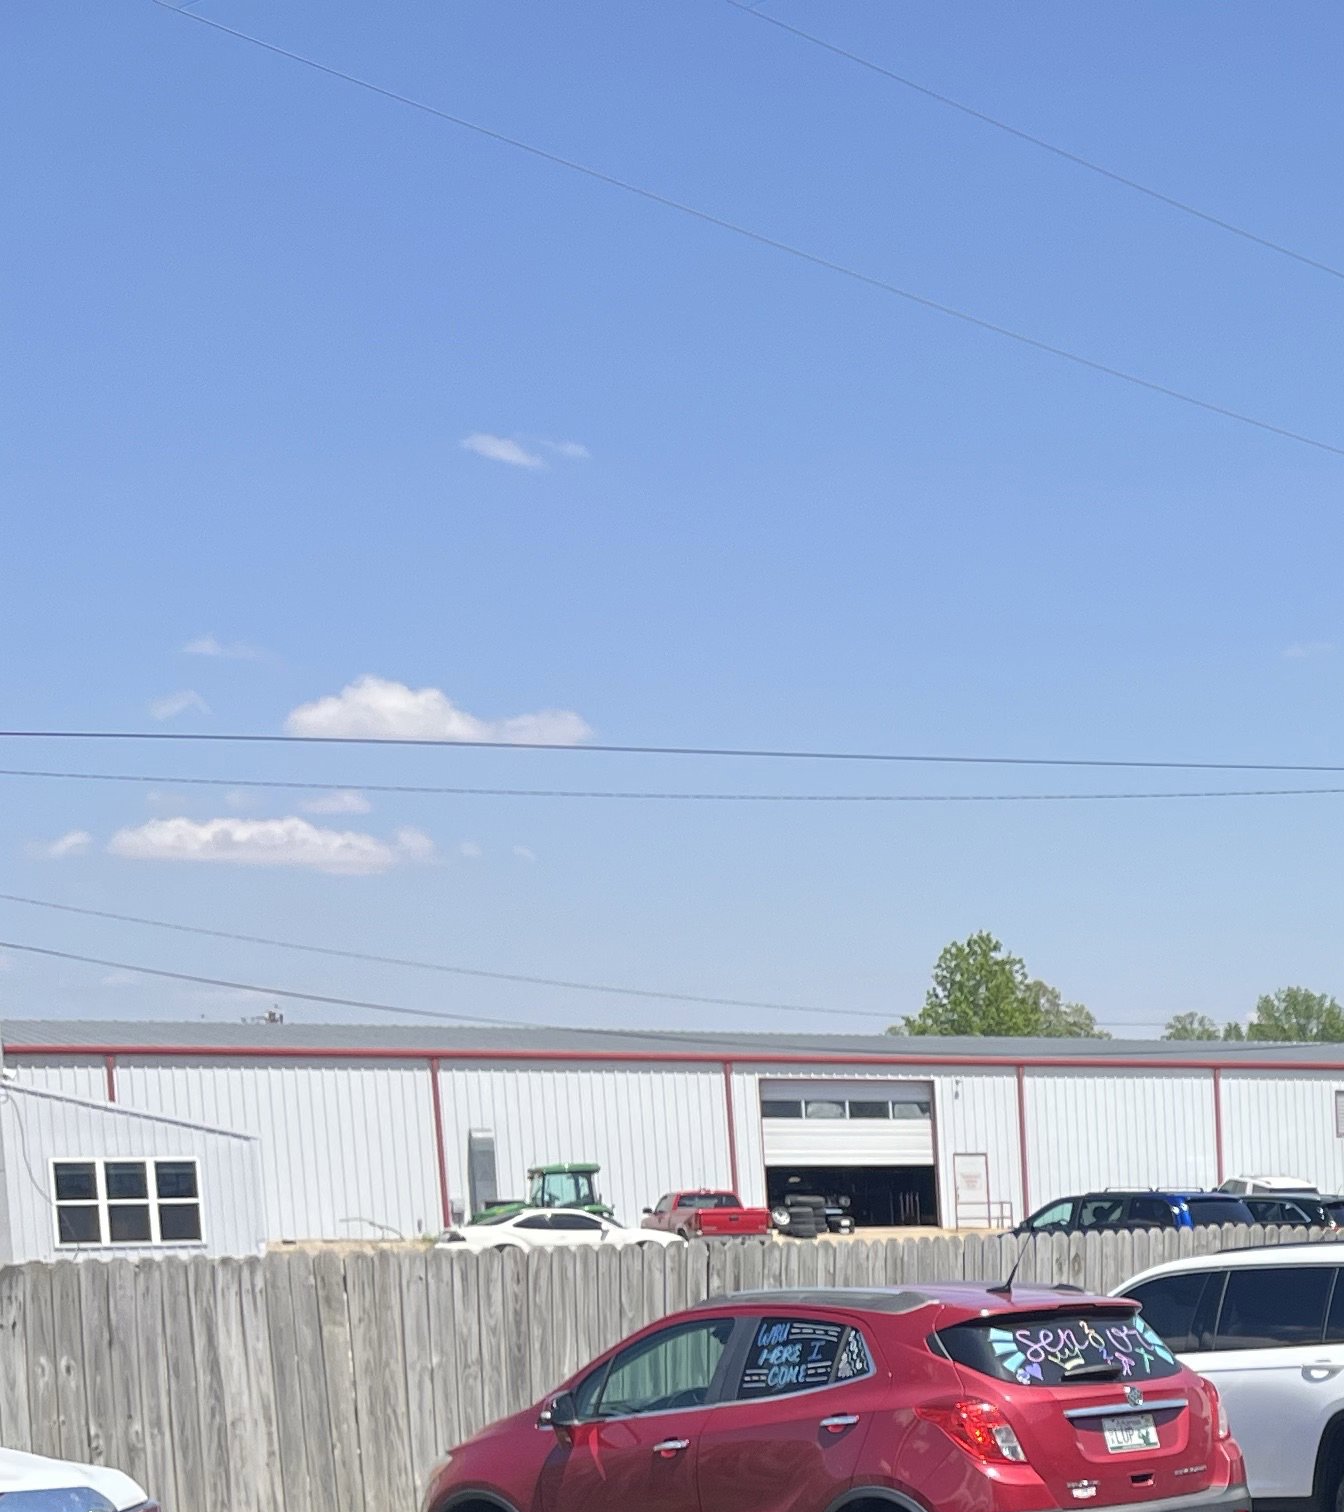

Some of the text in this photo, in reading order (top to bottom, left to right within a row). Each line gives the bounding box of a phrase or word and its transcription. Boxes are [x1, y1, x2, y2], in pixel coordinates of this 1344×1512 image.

[757, 1340, 826, 1367] HERE I
[767, 1363, 807, 1389] COME
